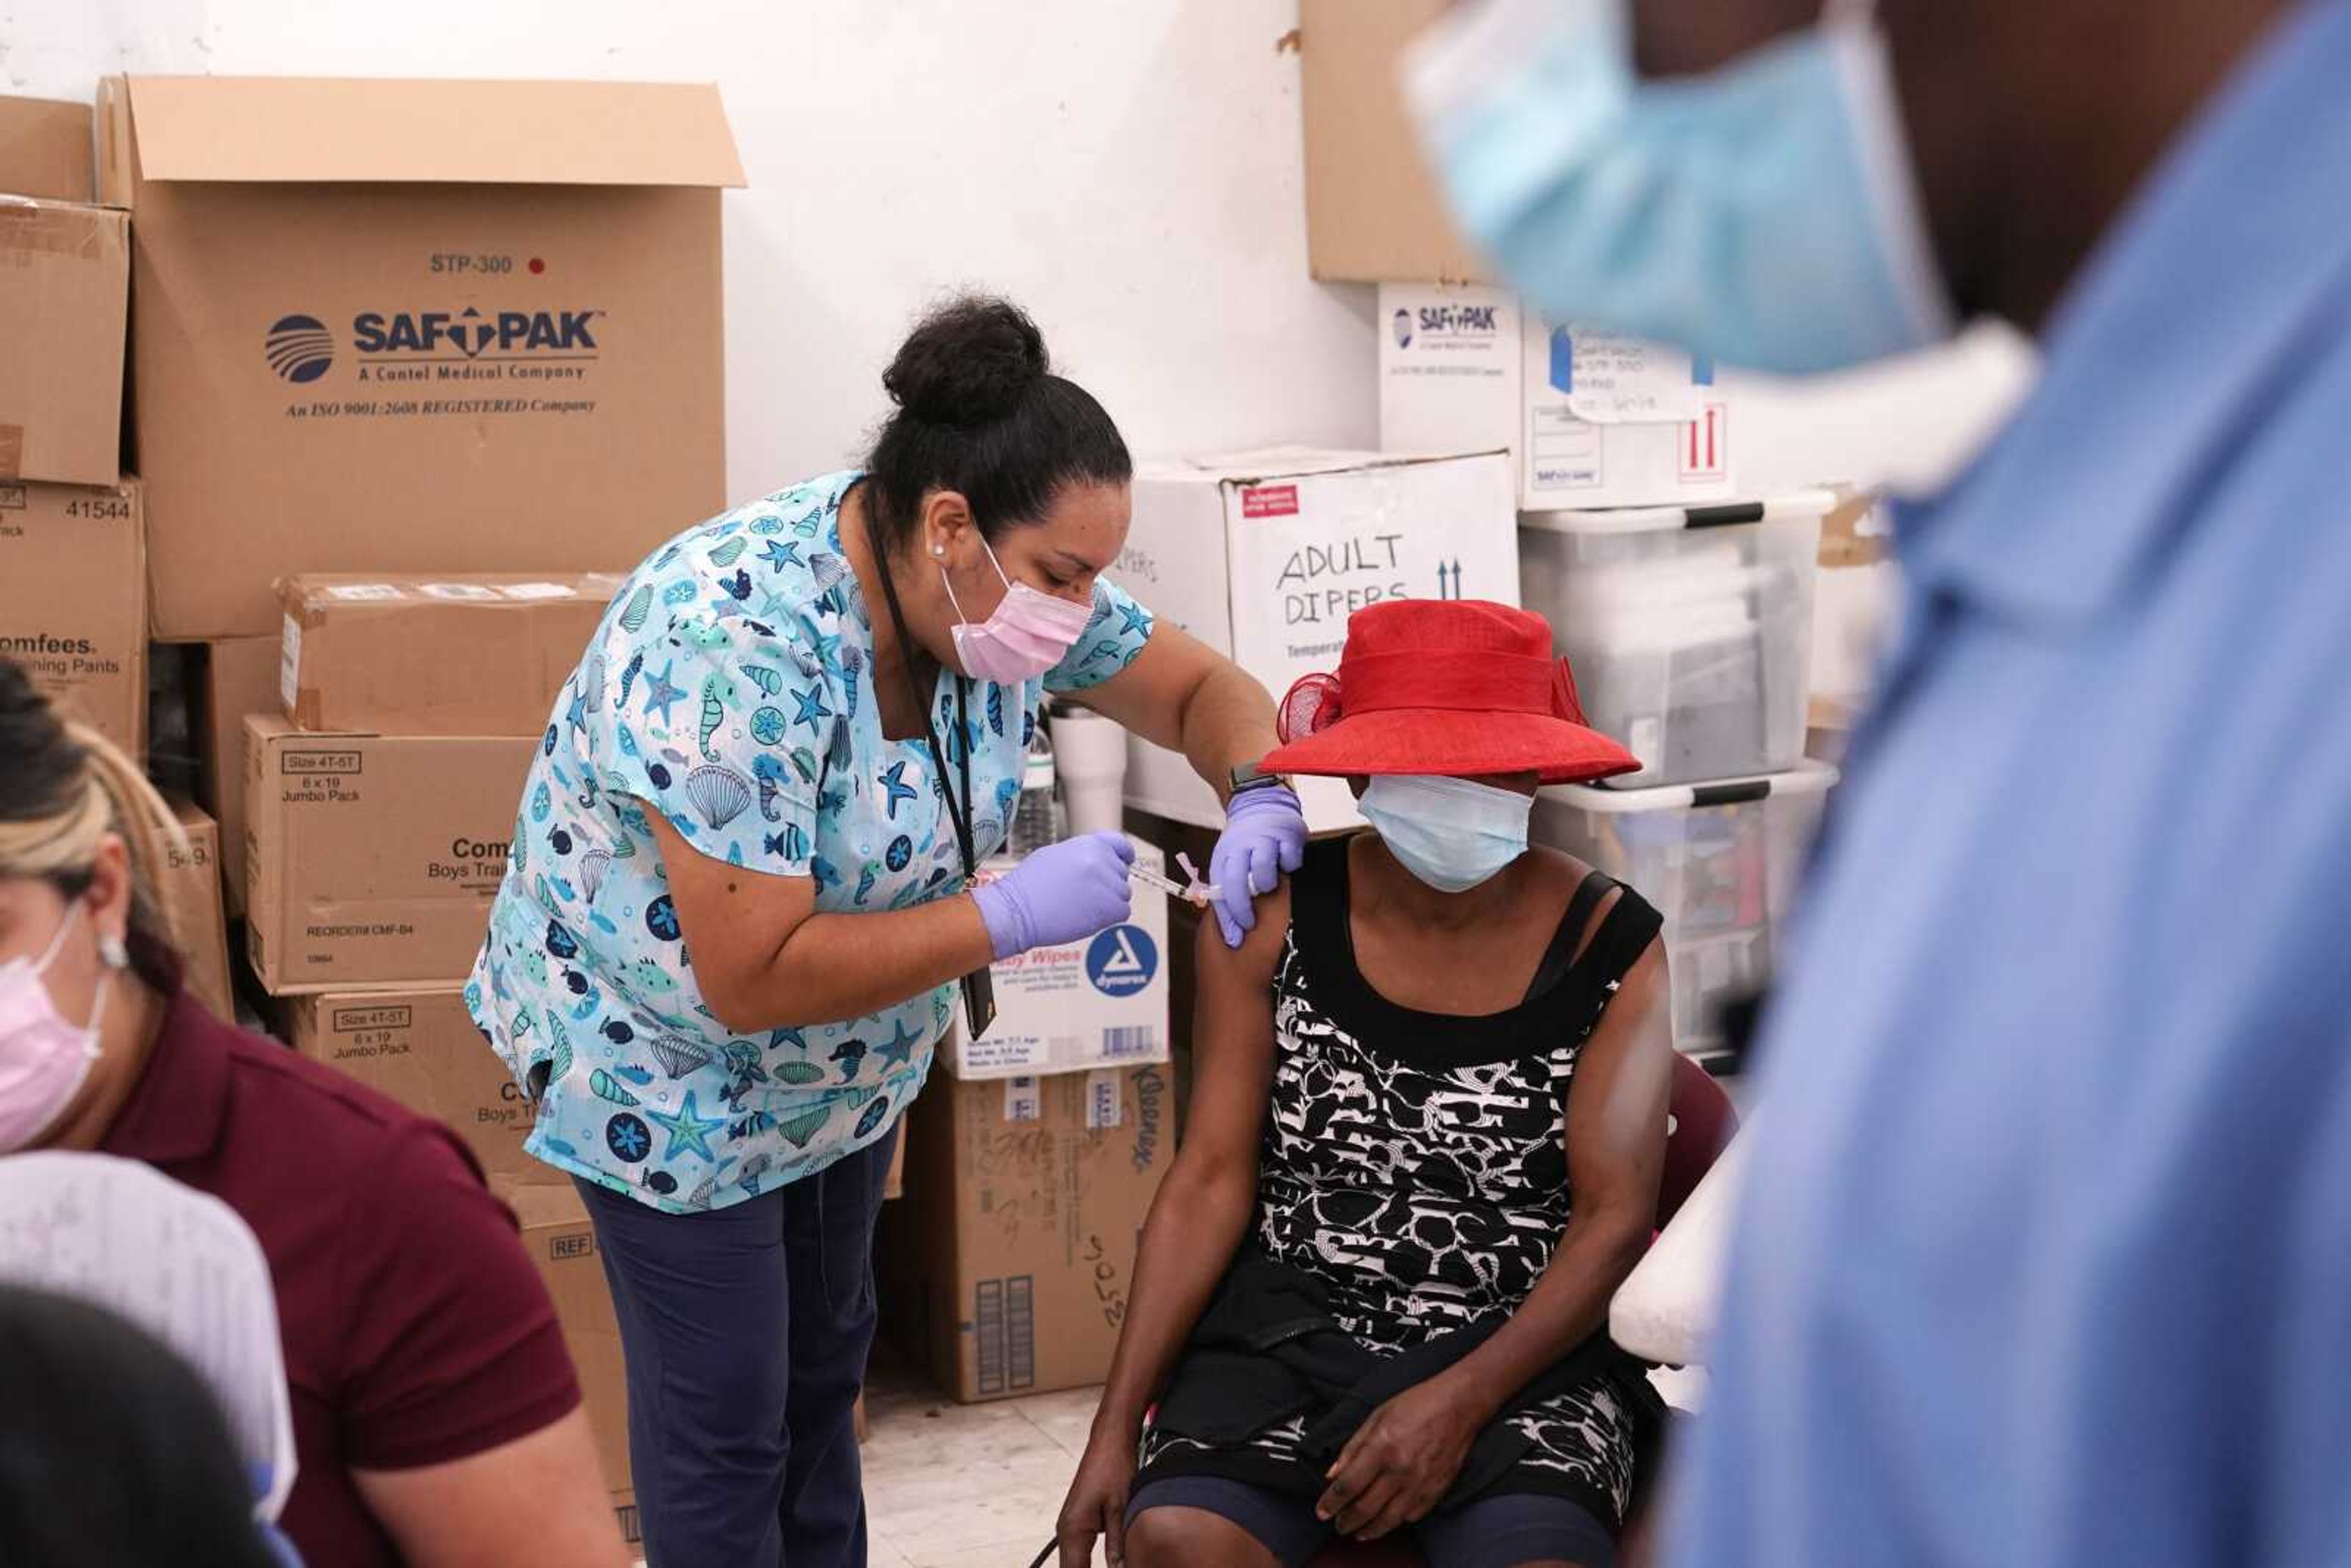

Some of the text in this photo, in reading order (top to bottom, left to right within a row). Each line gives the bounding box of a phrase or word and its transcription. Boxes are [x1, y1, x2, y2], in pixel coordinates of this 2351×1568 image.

[430, 255, 512, 274] STP-300
[359, 366, 585, 381] A Cantel Medical Company
[286, 405, 307, 417] An
[311, 404, 340, 416] ISO
[422, 400, 528, 414] REGISTERED
[531, 399, 596, 413] Company
[66, 500, 130, 519] 41544
[0, 526, 24, 537] ack
[1277, 534, 1403, 590] ADULT
[34, 659, 118, 675] ning Pants
[289, 756, 354, 768] Size 4T-5T
[282, 789, 360, 802] Jumbo Pack
[452, 838, 512, 858] Com
[429, 861, 508, 880] Boys Trai
[993, 950, 1081, 968] aby Wipes
[341, 1010, 405, 1026] Size 4T-5T
[334, 1043, 411, 1059] Jumbo Pack
[478, 1106, 516, 1123] Boys
[555, 1237, 589, 1256] REF
